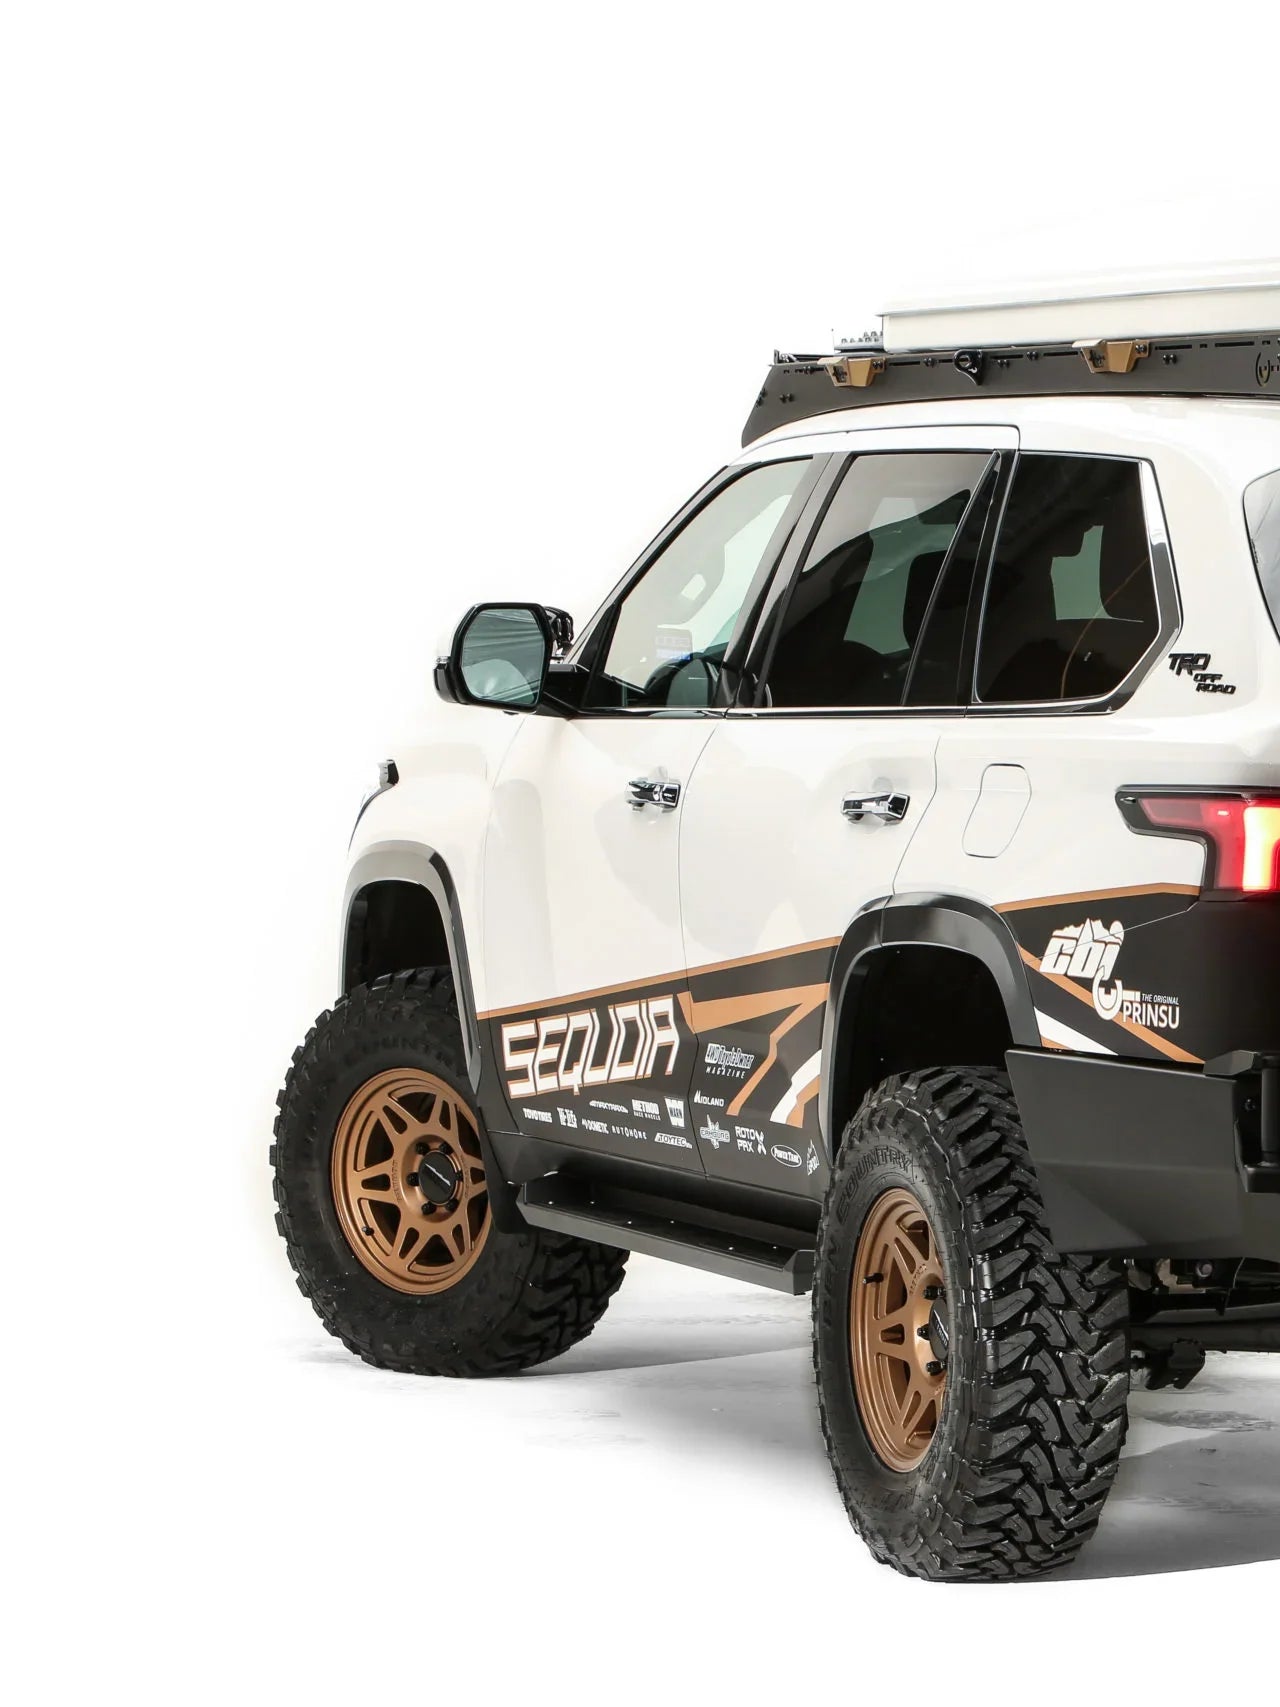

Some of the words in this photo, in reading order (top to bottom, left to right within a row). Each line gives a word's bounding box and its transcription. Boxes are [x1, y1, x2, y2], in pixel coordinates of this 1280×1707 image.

[1168, 653, 1211, 676] TRD
[1193, 673, 1223, 682] OFF
[1196, 682, 1236, 695] ROAD
[1142, 993, 1153, 1003] THE
[1153, 994, 1179, 1006] ORIGINAL
[1122, 1001, 1180, 1030] PRINSU
[501, 994, 679, 1099] SEQUOIA
[706, 1066, 746, 1079] MAGAZINE
[694, 1090, 725, 1107] MIDLAND
